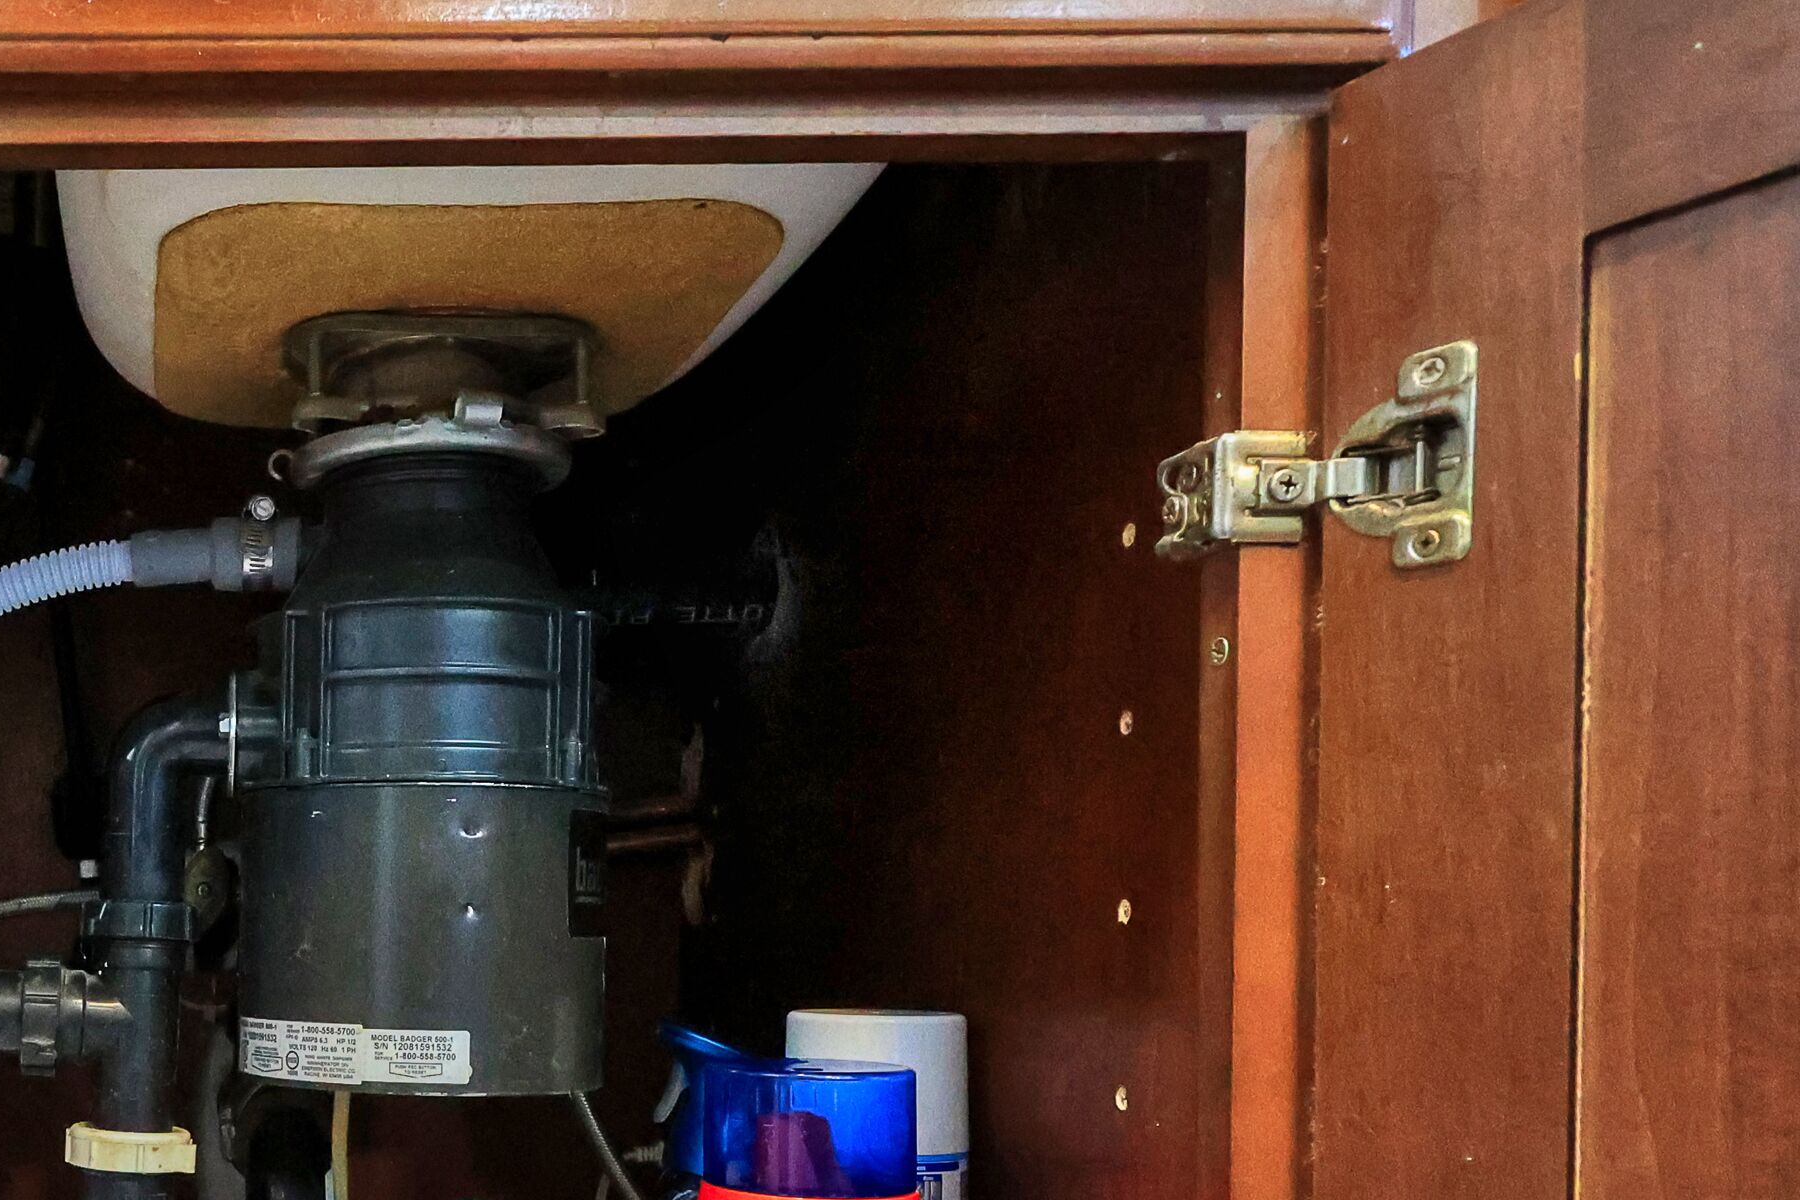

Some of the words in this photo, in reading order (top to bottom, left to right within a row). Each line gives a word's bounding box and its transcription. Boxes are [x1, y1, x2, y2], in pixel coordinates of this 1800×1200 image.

[301, 1026, 356, 1036] 1-800-558-5700
[371, 1034, 398, 1042] MODEL
[400, 1035, 433, 1043] BADGER
[374, 1042, 389, 1050] S/N
[393, 1043, 452, 1052] 12081591532
[395, 1052, 456, 1061] 1-800-558-5700
